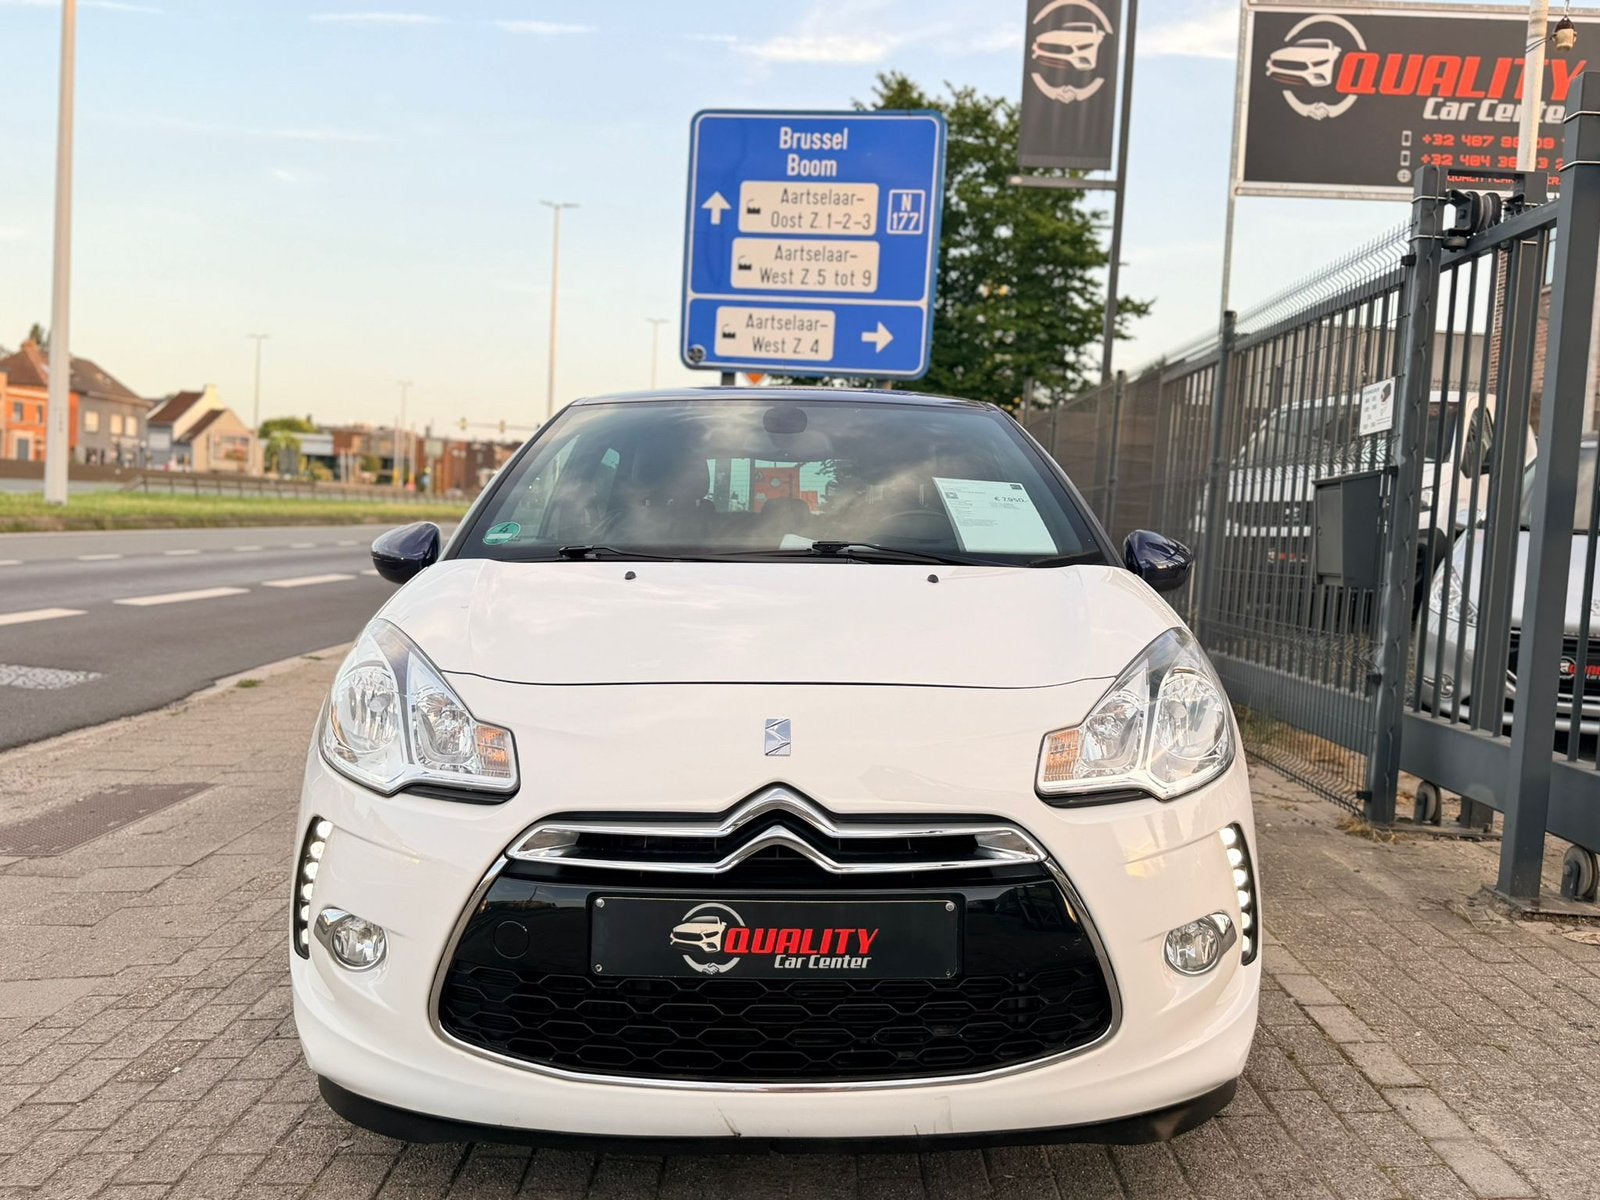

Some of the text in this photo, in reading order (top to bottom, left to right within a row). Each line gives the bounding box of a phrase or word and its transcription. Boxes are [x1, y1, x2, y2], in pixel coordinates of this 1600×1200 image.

[1336, 53, 1587, 100] QUALITY
[1423, 98, 1567, 123] Car Cete
[779, 126, 848, 150] Brussel
[1421, 133, 1455, 147] +32
[1461, 135, 1495, 148] 487
[786, 153, 838, 177] Boom
[1420, 153, 1454, 167] +32
[1459, 154, 1492, 168] 484
[780, 188, 865, 206] Aartselaar-
[901, 193, 912, 212] N
[771, 211, 803, 229] Oost
[827, 213, 871, 231] 1-2-3
[891, 212, 920, 231] 177
[774, 245, 858, 263] Aartselaar-
[759, 267, 794, 285] West
[834, 269, 855, 286] tot
[862, 271, 872, 288] 9
[745, 313, 828, 331] Aartselaar-
[752, 336, 786, 354] West
[810, 339, 820, 355] 4
[724, 928, 879, 955] QUALITY
[774, 954, 872, 969] Car Center
